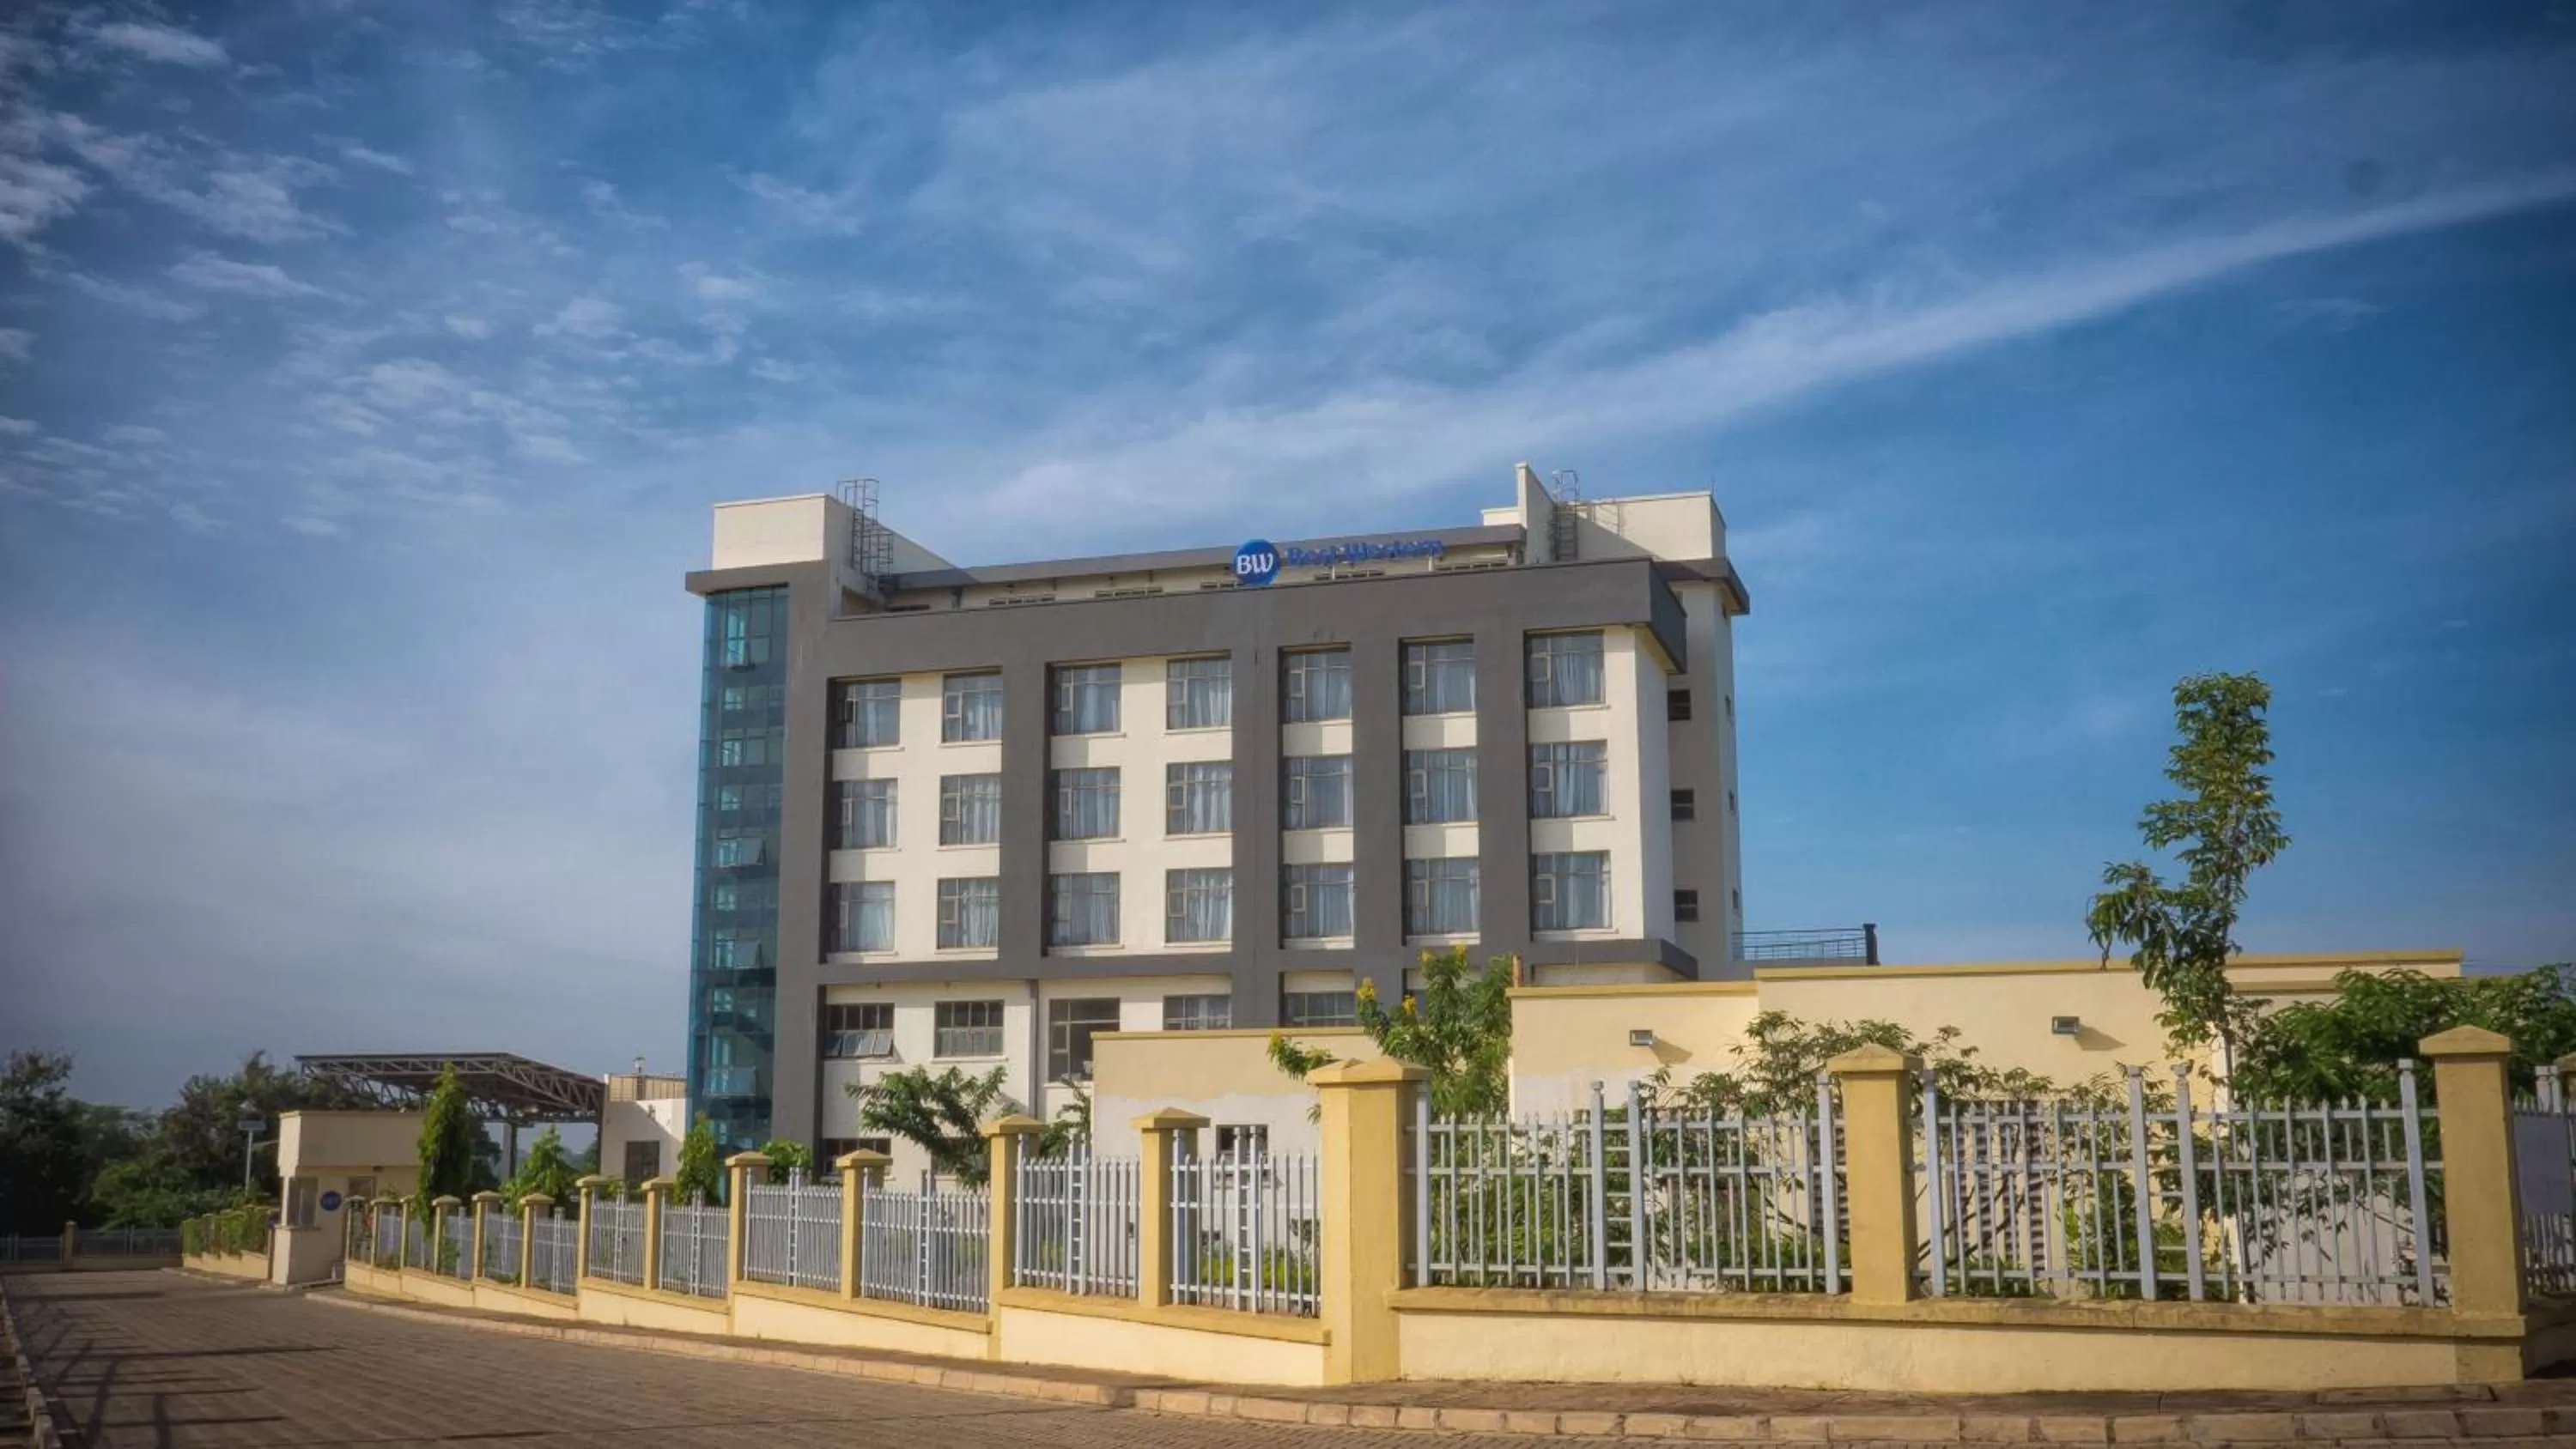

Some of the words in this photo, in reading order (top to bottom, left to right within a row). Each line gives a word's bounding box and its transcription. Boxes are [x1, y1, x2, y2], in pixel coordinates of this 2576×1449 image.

[1236, 553, 1273, 574] BW
[1286, 546, 1336, 567] Best
[1342, 539, 1443, 561] Western
